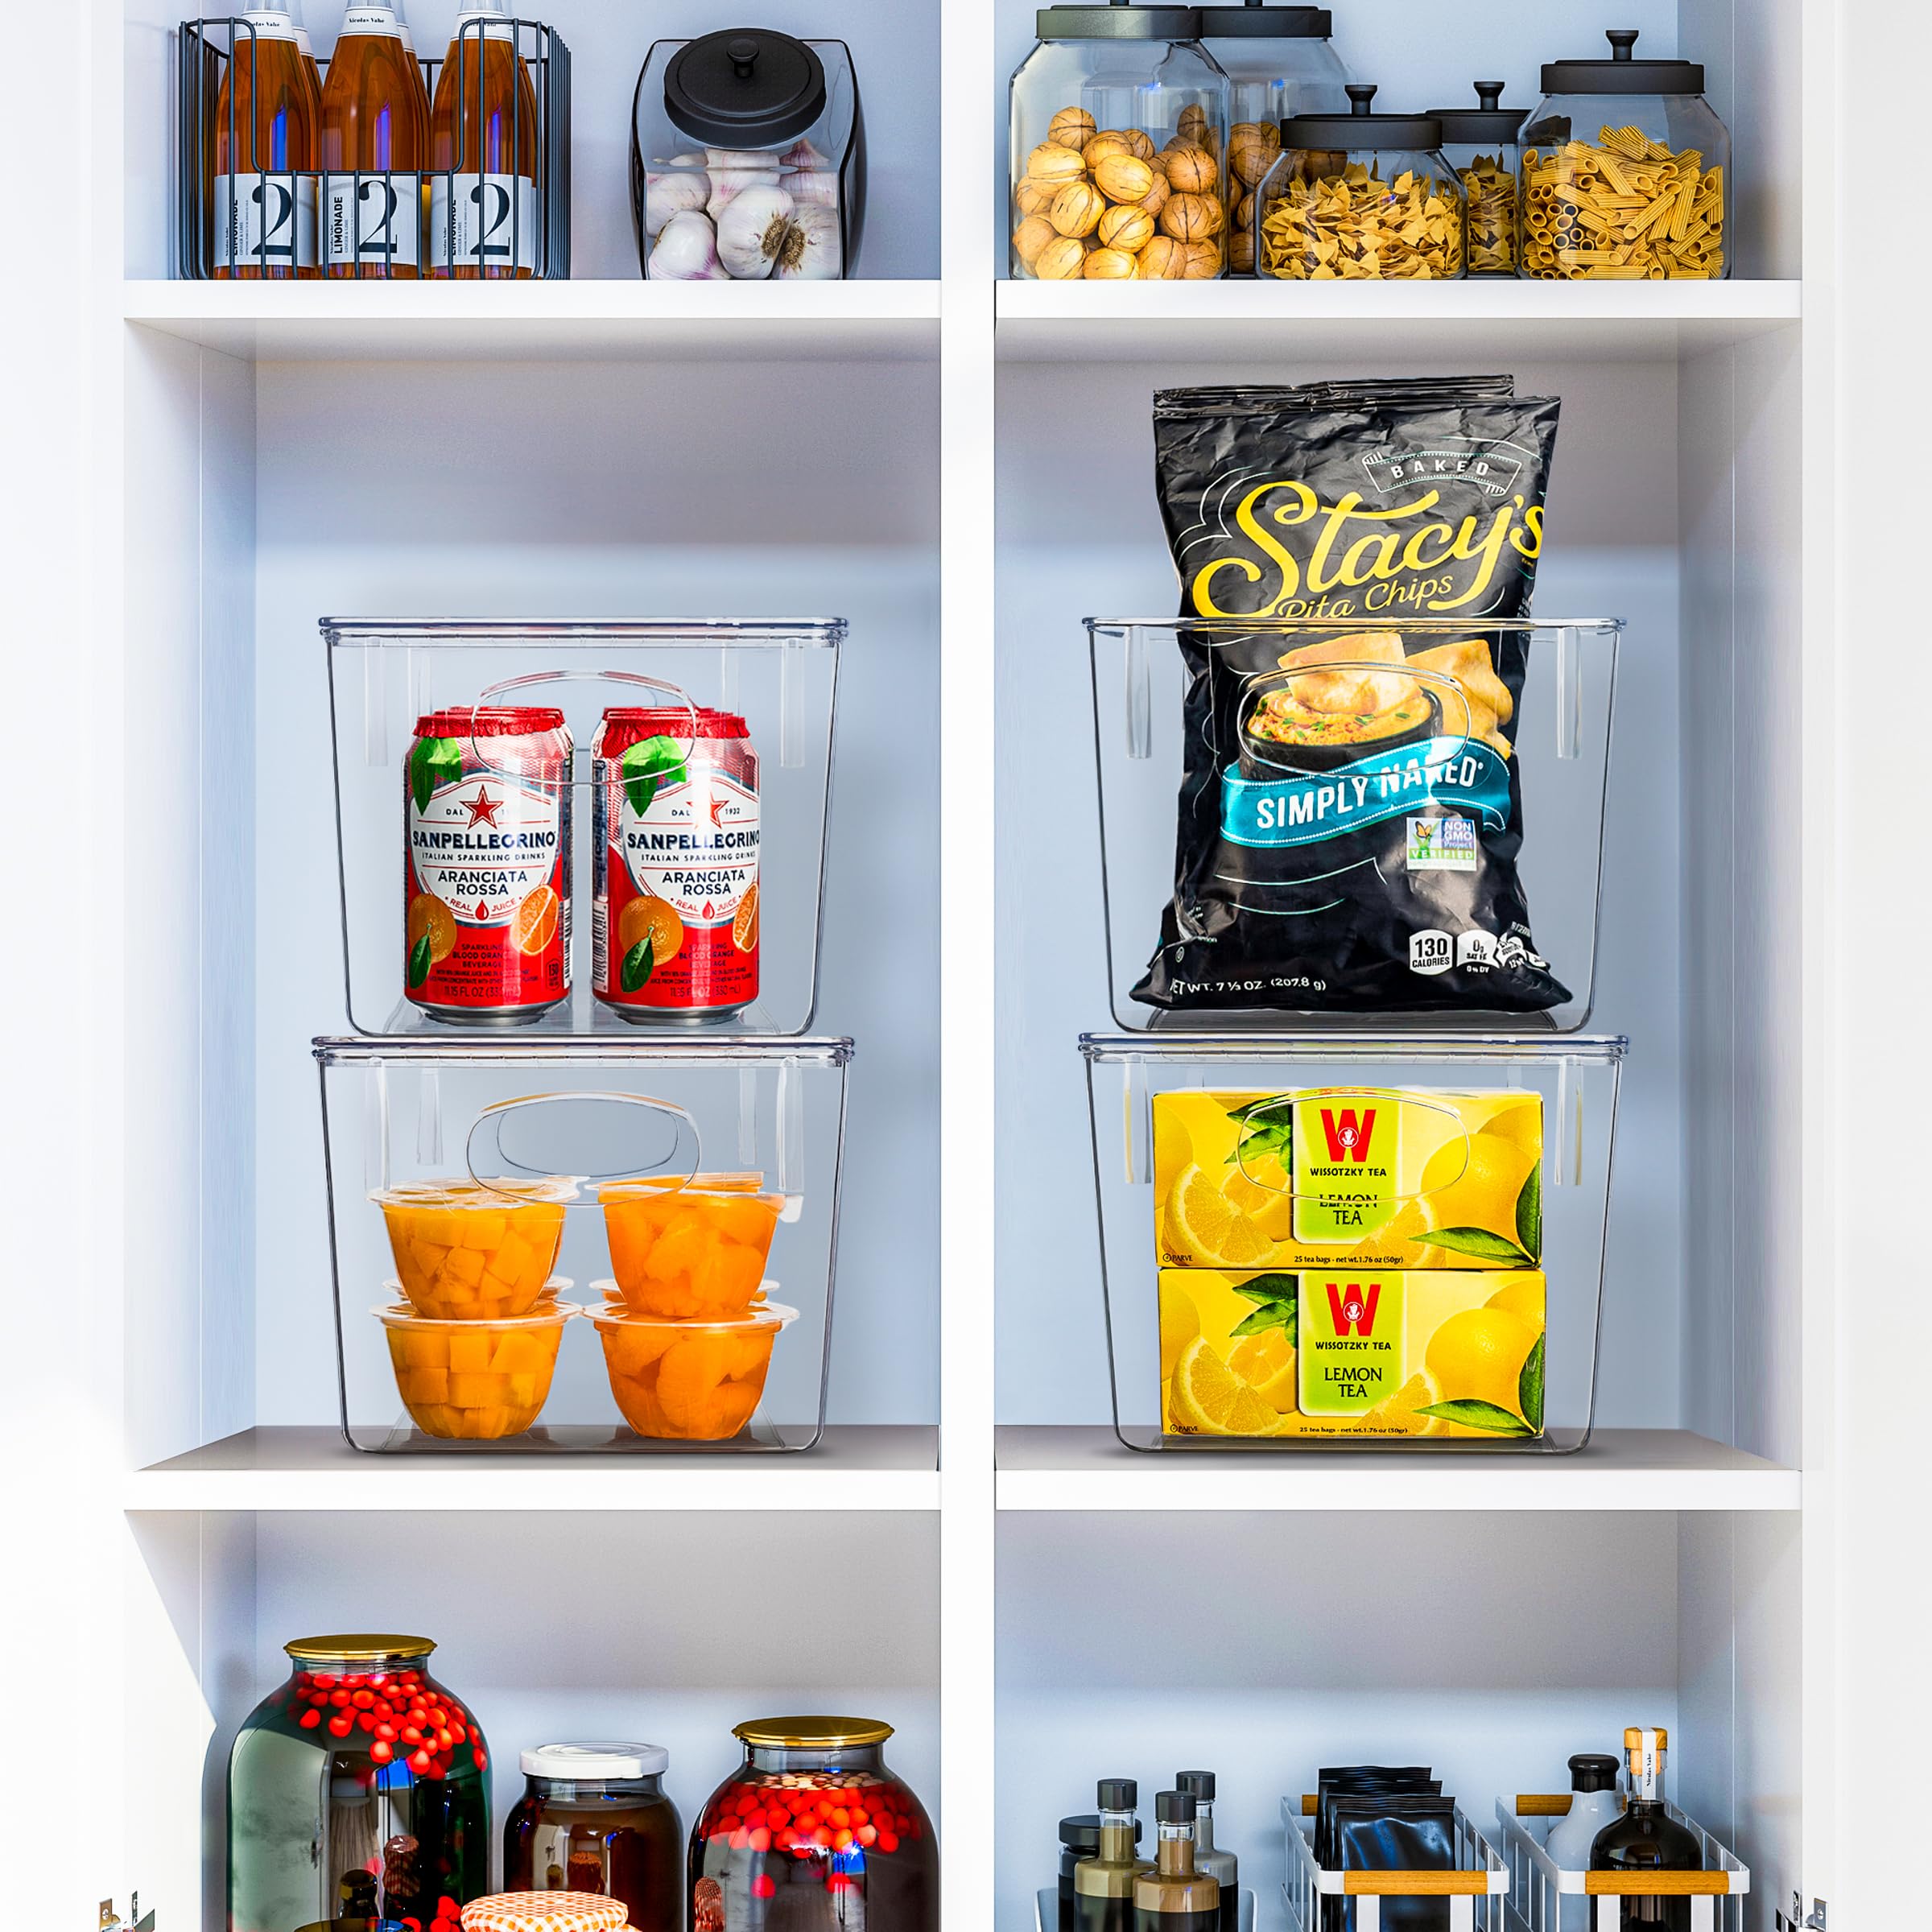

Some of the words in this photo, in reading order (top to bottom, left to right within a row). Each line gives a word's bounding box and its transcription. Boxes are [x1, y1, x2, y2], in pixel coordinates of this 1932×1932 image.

[251, 183, 293, 255] 2
[357, 180, 398, 254] 2
[470, 183, 510, 256] 2
[334, 196, 343, 254] LIMONADE
[1391, 459, 1491, 479] BAKED
[1191, 481, 1545, 618] Stacy's
[1278, 595, 1356, 618] Pita
[1364, 575, 1453, 611] Chips
[1257, 776, 1368, 829] SIMPLY
[1380, 755, 1477, 798] NAKED
[1444, 821, 1471, 832] NON
[413, 831, 555, 849] SANPELLEGRINO
[1444, 831, 1473, 841] GMO
[422, 852, 453, 861] ITALIAN
[515, 852, 545, 861] DRINKS
[684, 853, 733, 861] SPARKLING
[1411, 849, 1473, 859] VERIFIED
[438, 871, 527, 882] ARANCIATA
[663, 869, 745, 883] ARANCIATA
[456, 884, 509, 895] ROSSA
[683, 883, 731, 895] ROSSA
[449, 899, 473, 911] REAL
[492, 898, 516, 912] JUICE
[675, 899, 699, 912] REAL
[717, 897, 737, 911] JUICE
[1414, 938, 1447, 958] 130
[481, 952, 514, 960] ORAN
[1412, 956, 1450, 968] CALORIES
[460, 986, 470, 997] FL
[471, 986, 483, 997] OZ
[1187, 982, 1213, 993] WT.
[1216, 982, 1224, 991] 7
[1244, 980, 1266, 991] OZ.
[1270, 977, 1310, 988] (207.8
[1313, 980, 1327, 991] g)
[1310, 1168, 1364, 1176] WISSOTZKY
[1368, 1168, 1387, 1176] TEA
[1319, 1194, 1378, 1208] LEMON
[1333, 1210, 1363, 1225] TEA
[1316, 1256, 1331, 1264] bags
[1383, 1256, 1404, 1264] (50gr)
[1315, 1341, 1368, 1350] WISSOTZKY
[1373, 1342, 1391, 1350] TEA
[1324, 1368, 1382, 1381] LEMON
[1338, 1384, 1368, 1397] TEA
